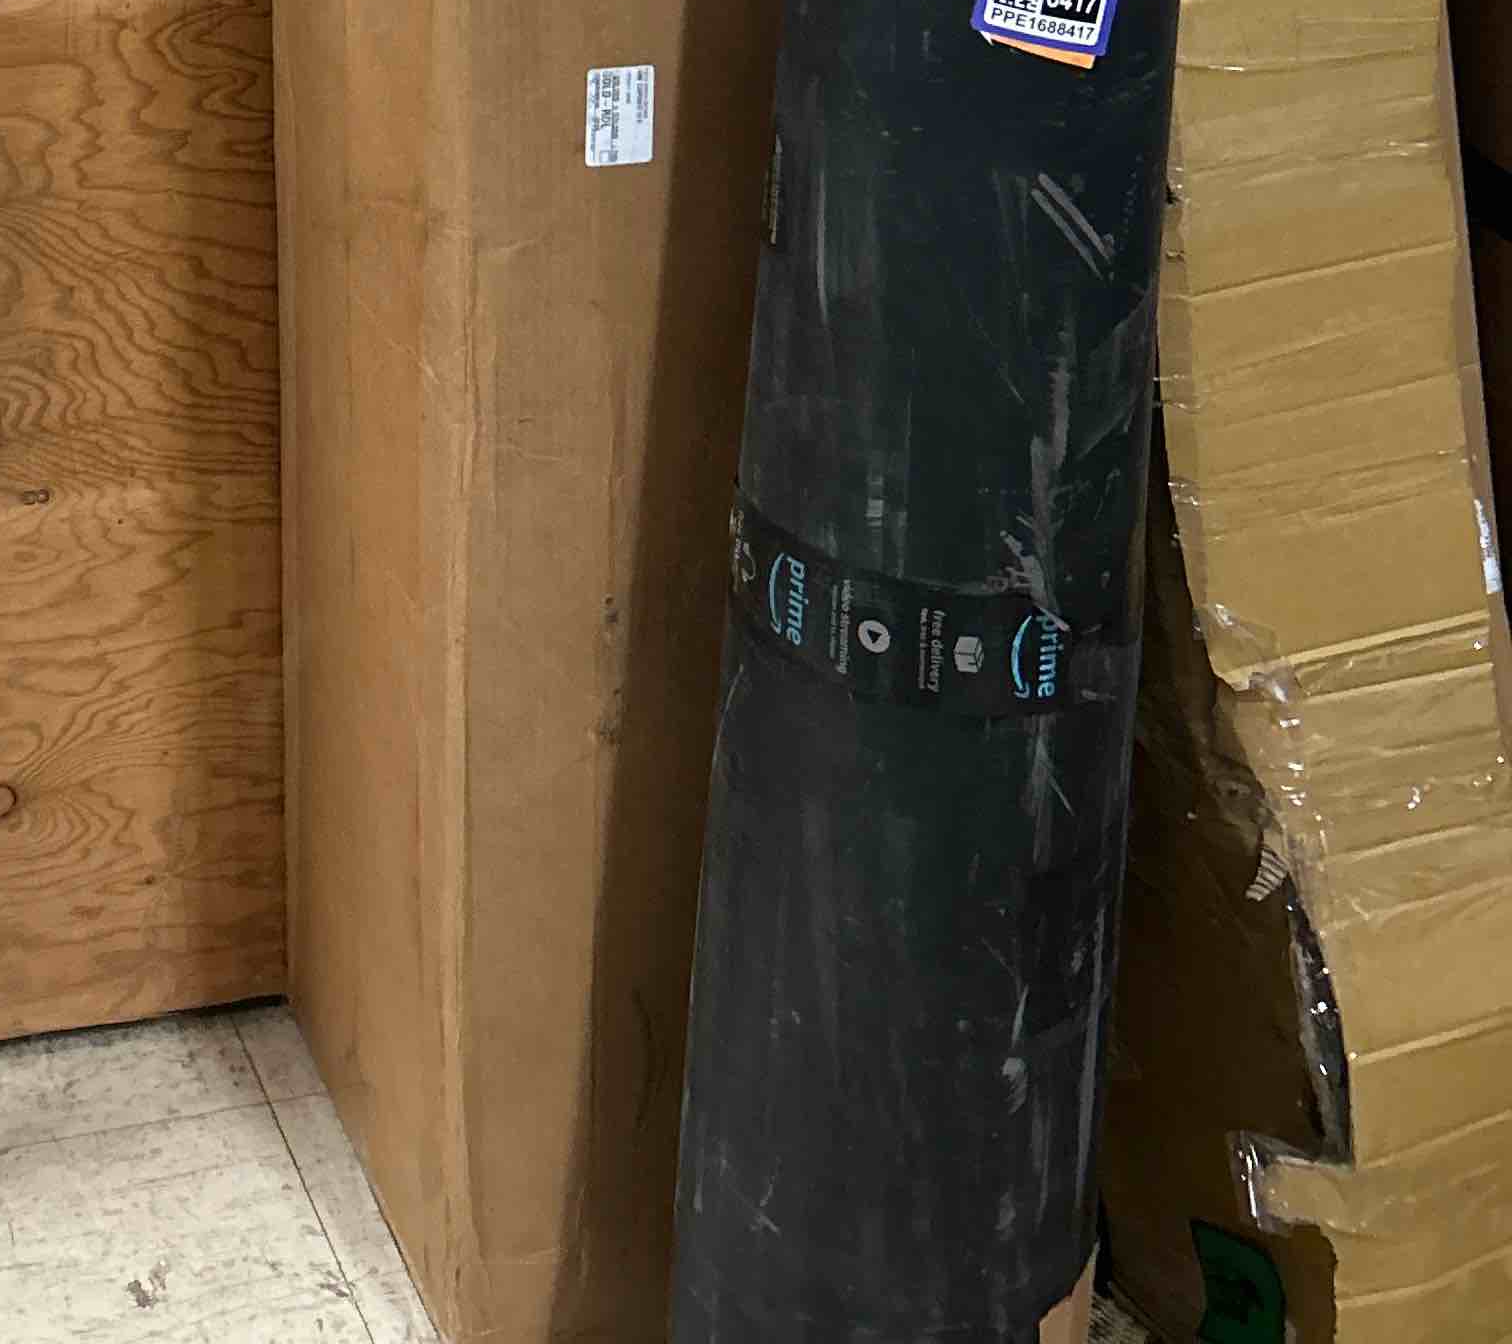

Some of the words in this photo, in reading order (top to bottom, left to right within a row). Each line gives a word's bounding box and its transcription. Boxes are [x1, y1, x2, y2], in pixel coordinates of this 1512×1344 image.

[991, 7, 1096, 41] PPE1688417
[787, 555, 809, 646] prime
[933, 610, 946, 639] free
[927, 640, 945, 693] delivery
[1037, 613, 1065, 698] prime
